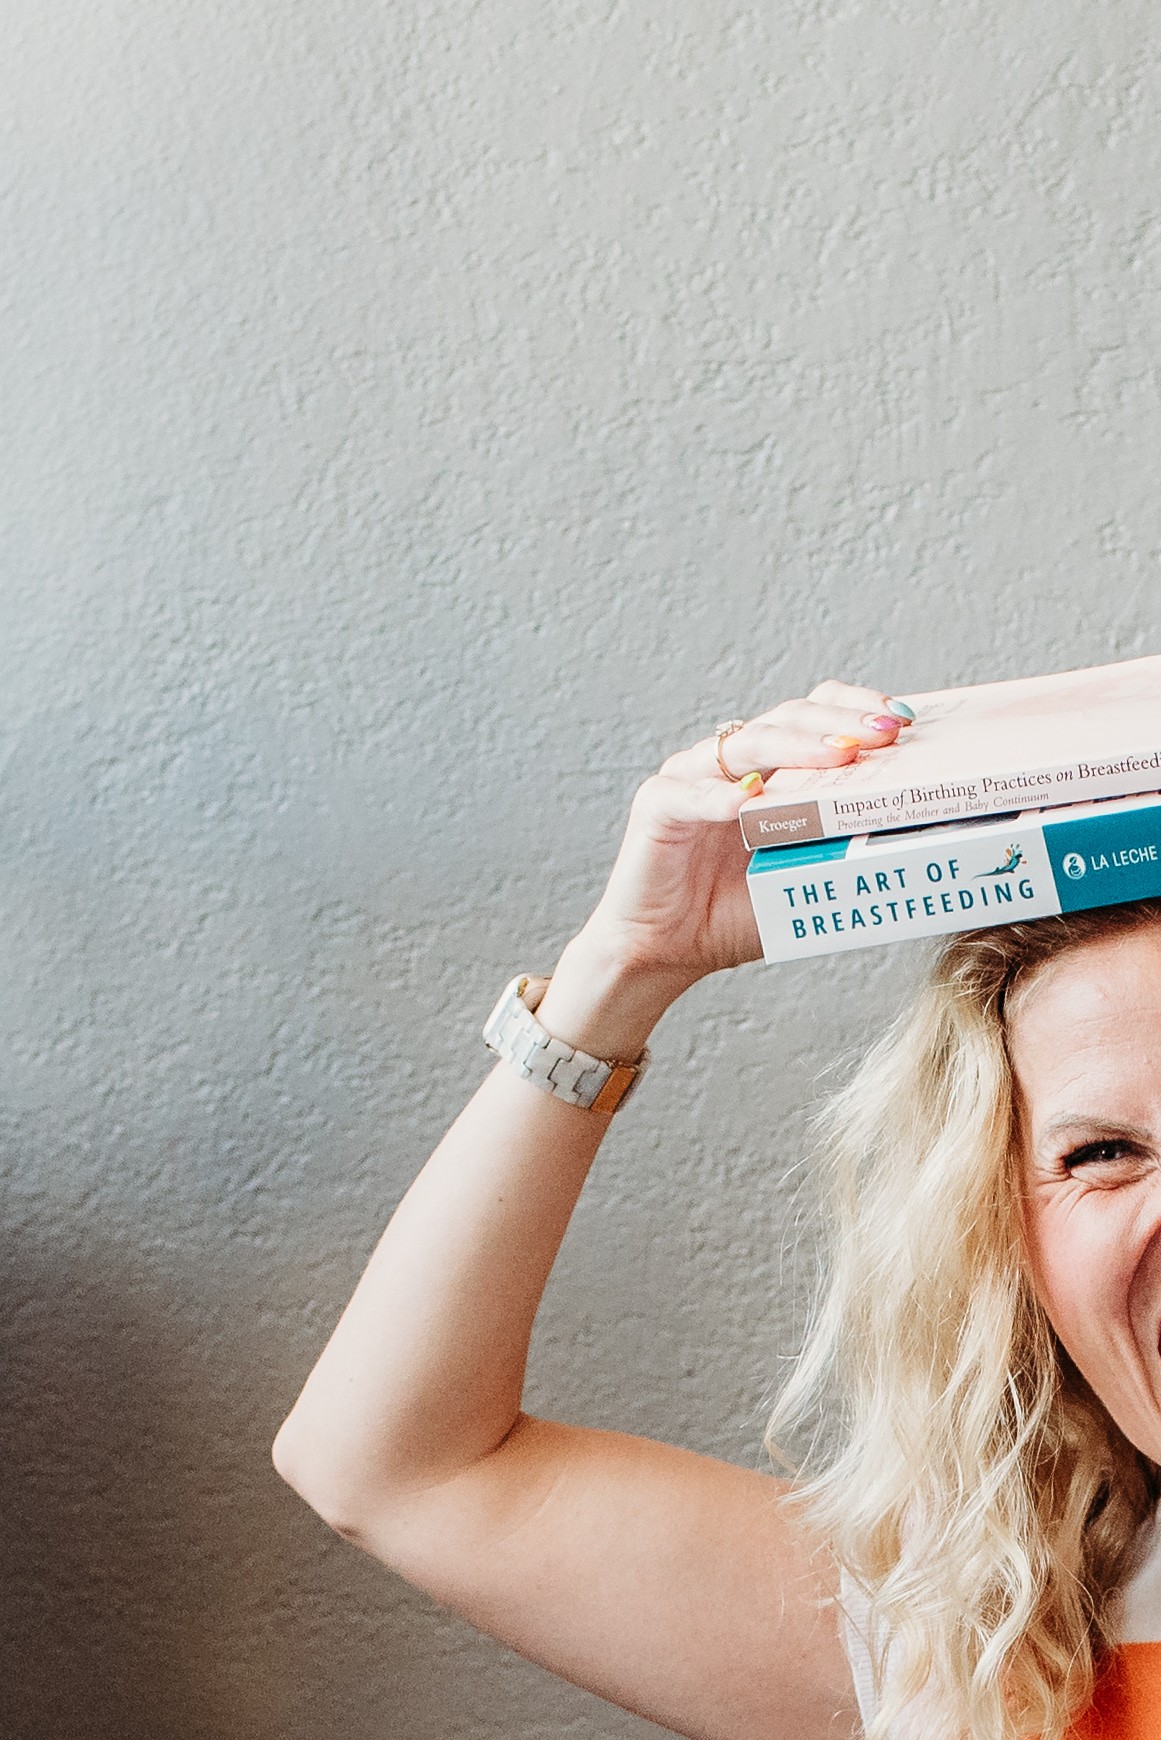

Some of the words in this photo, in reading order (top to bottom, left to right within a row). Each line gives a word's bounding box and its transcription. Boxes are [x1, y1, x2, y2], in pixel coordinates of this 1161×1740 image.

[833, 796, 888, 816] Impact
[893, 789, 906, 810] of
[909, 781, 978, 804] Birthing
[981, 770, 1053, 793] Practices
[1056, 770, 1074, 783] on
[837, 815, 884, 831] Protecting
[887, 811, 901, 823] the
[904, 806, 939, 820] Mother
[943, 803, 960, 815] and
[964, 797, 989, 812] Baby
[993, 791, 1050, 808] Continuum
[759, 816, 808, 834] Kroeger
[1091, 854, 1110, 871] LA
[1112, 845, 1158, 868] LECHE
[783, 880, 837, 908] THE
[856, 868, 907, 896] ART
[925, 858, 961, 883] OF
[792, 878, 1035, 940] BREASTFEEDING
